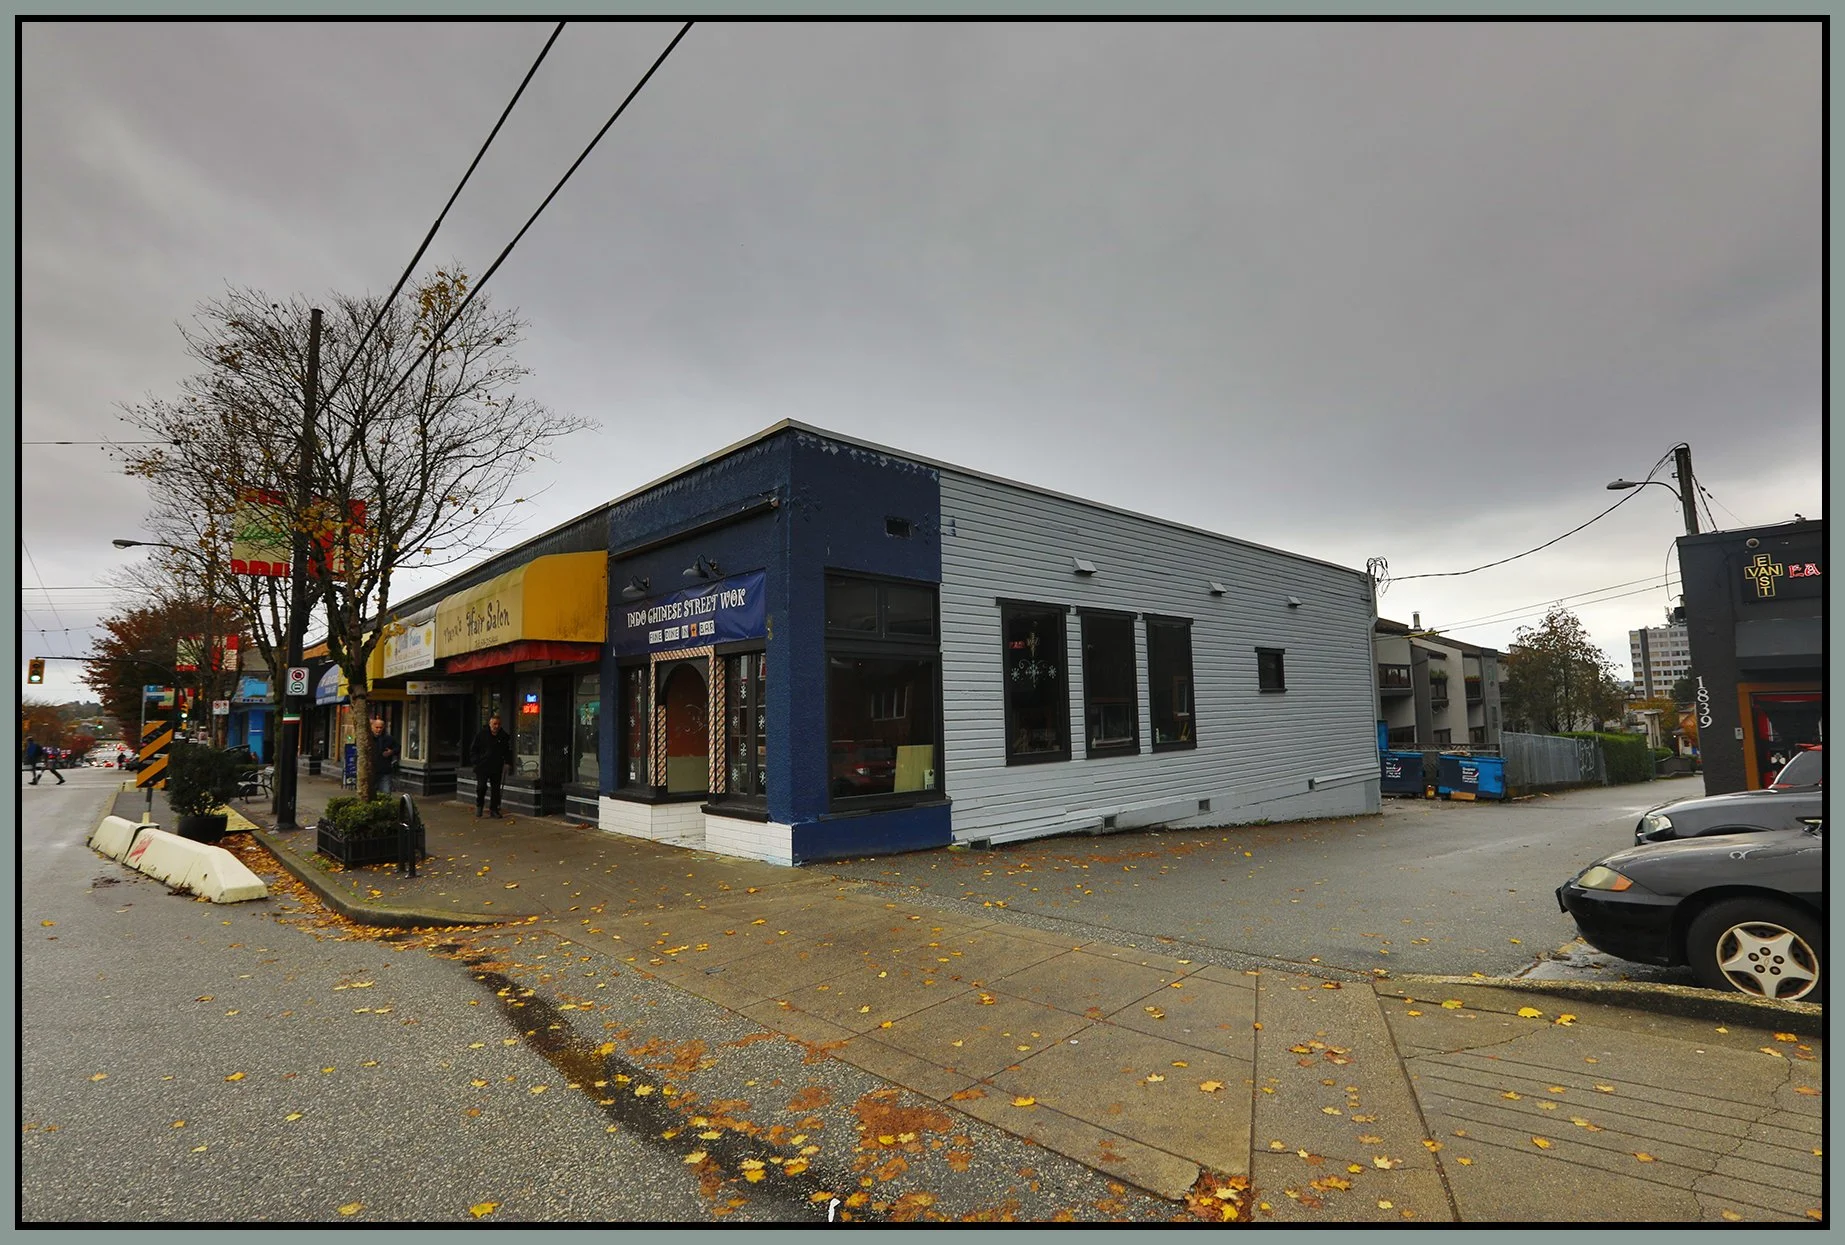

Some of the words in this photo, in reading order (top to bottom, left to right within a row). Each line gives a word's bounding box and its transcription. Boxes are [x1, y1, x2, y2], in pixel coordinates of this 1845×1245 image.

[1748, 565, 1779, 577] VAN
[466, 607, 485, 636] Hair
[487, 600, 509, 631] Salon
[627, 610, 646, 627] INDO
[648, 602, 682, 624] CHINESE
[683, 594, 718, 617] STREET
[720, 588, 746, 610] WOK
[649, 631, 662, 643] FINE
[665, 628, 679, 640] DINE
[1696, 675, 1713, 729] 1839
